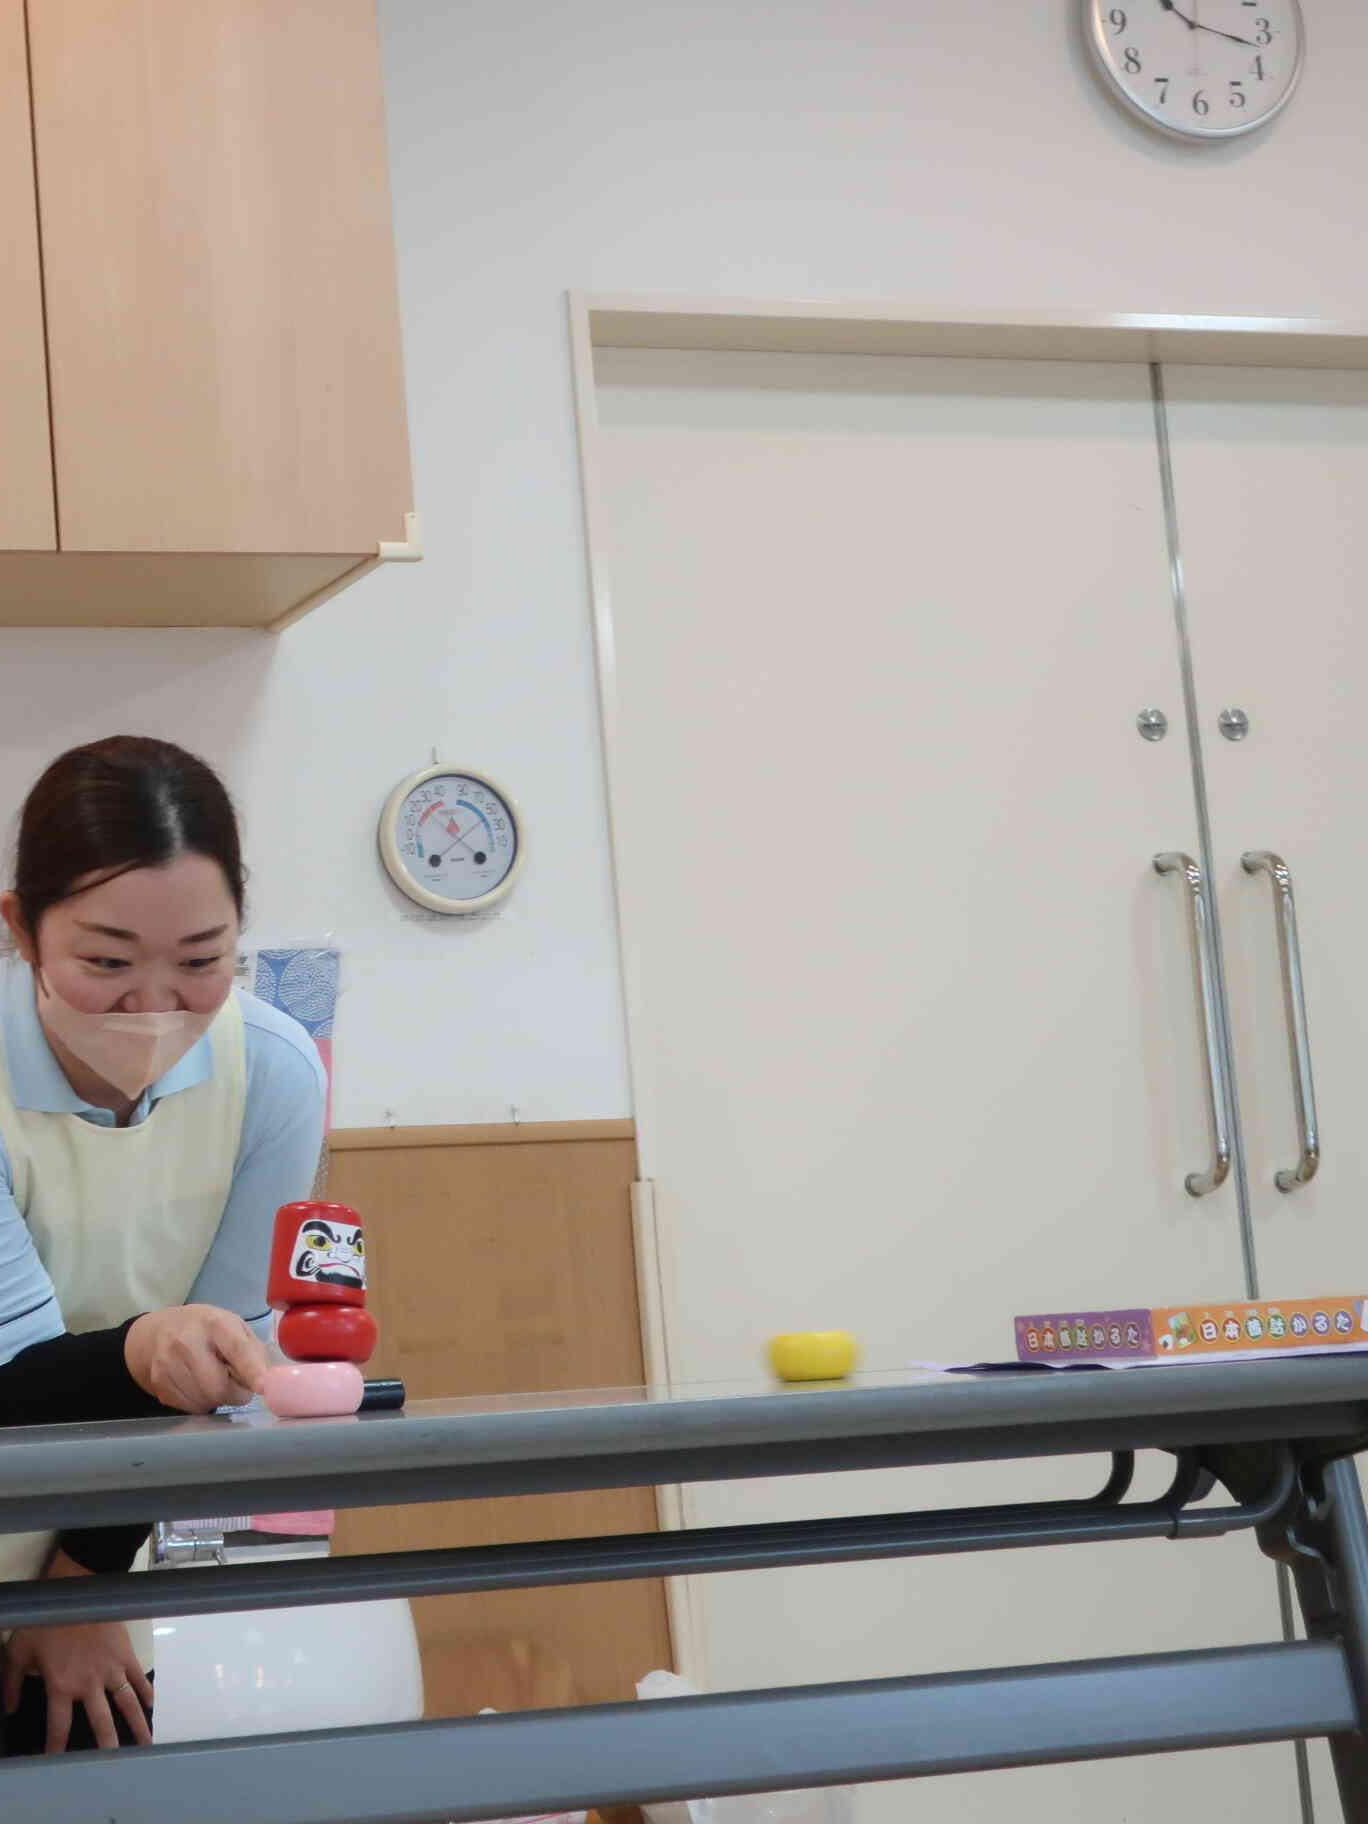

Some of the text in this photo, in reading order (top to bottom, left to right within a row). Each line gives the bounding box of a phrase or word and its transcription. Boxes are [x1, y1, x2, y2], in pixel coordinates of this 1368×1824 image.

[1109, 9, 1127, 36] 9
[1255, 18, 1273, 45] 3
[1124, 47, 1141, 74] 8
[1251, 55, 1273, 81] 4
[1154, 77, 1169, 104] 7
[1192, 88, 1209, 116] 6
[1229, 81, 1245, 108] 5
